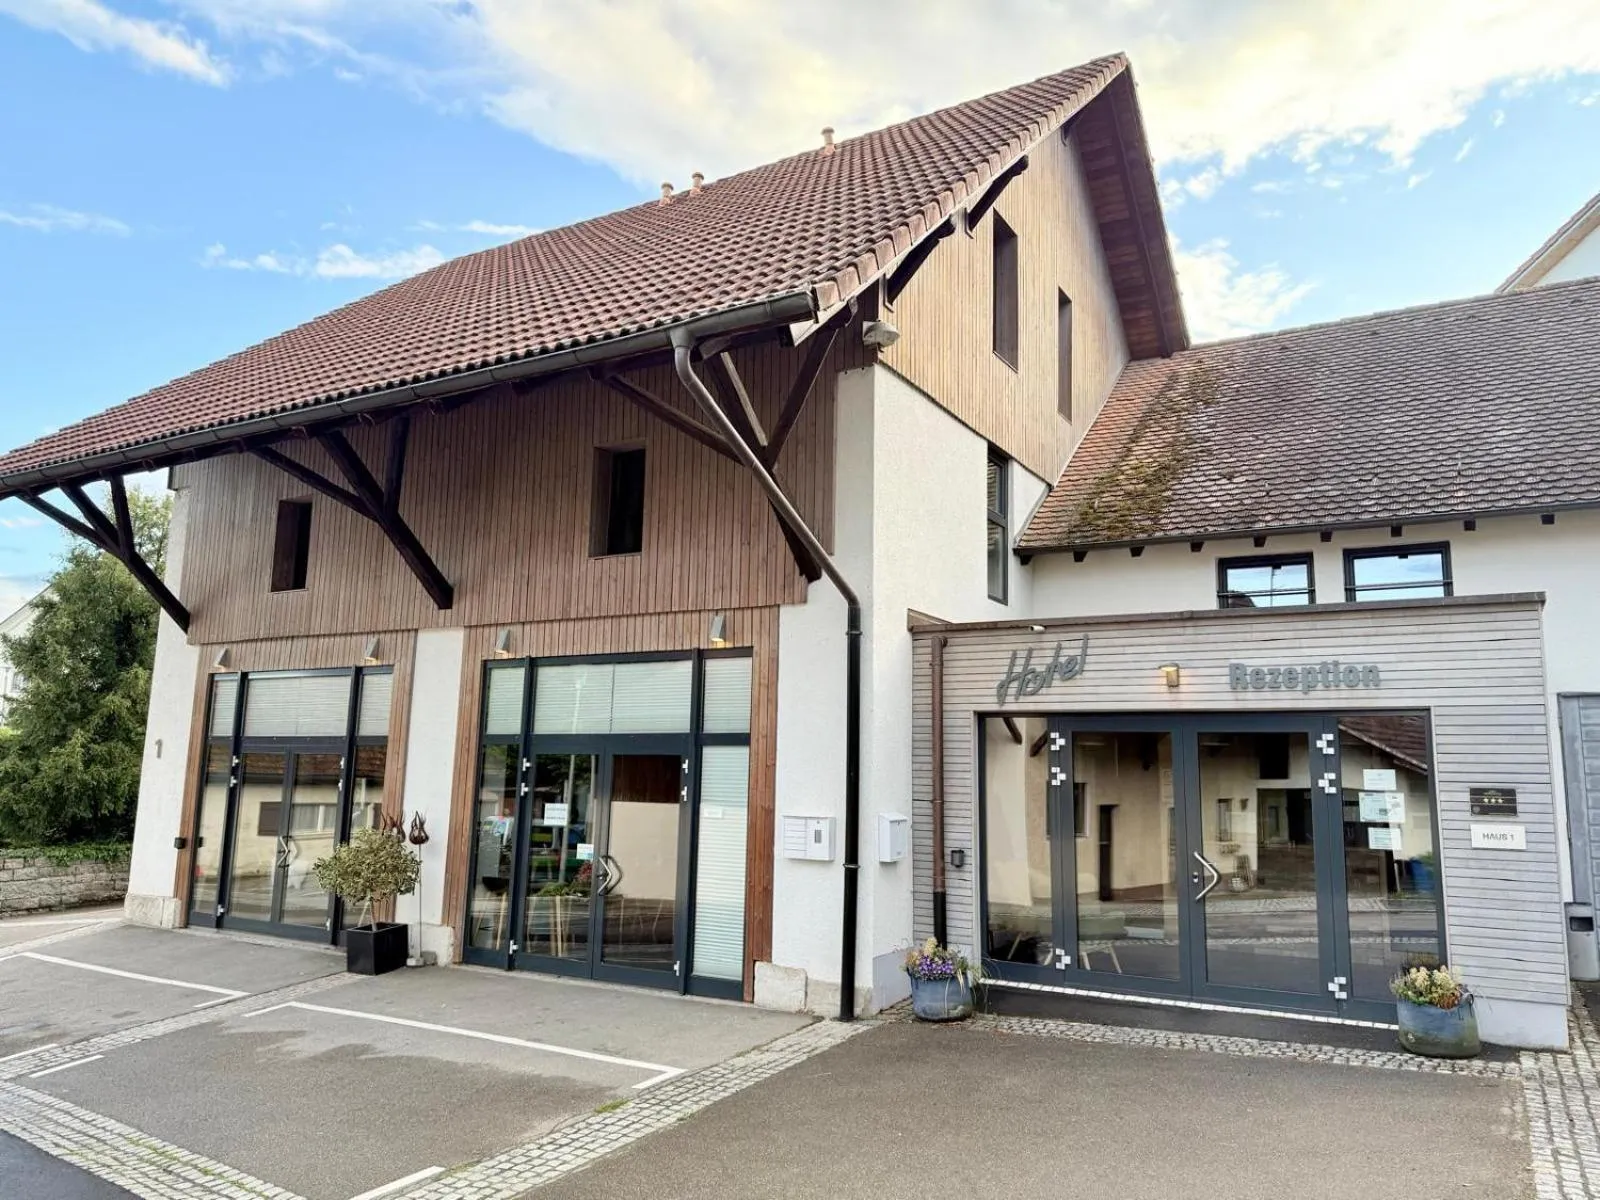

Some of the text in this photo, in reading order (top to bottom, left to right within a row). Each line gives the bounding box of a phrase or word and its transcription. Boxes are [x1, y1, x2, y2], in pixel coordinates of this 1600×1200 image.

[996, 633, 1090, 706] Hotel
[1228, 660, 1382, 695] Rezeption
[154, 739, 163, 759] 1
[1482, 832, 1515, 841] HAUS 1
